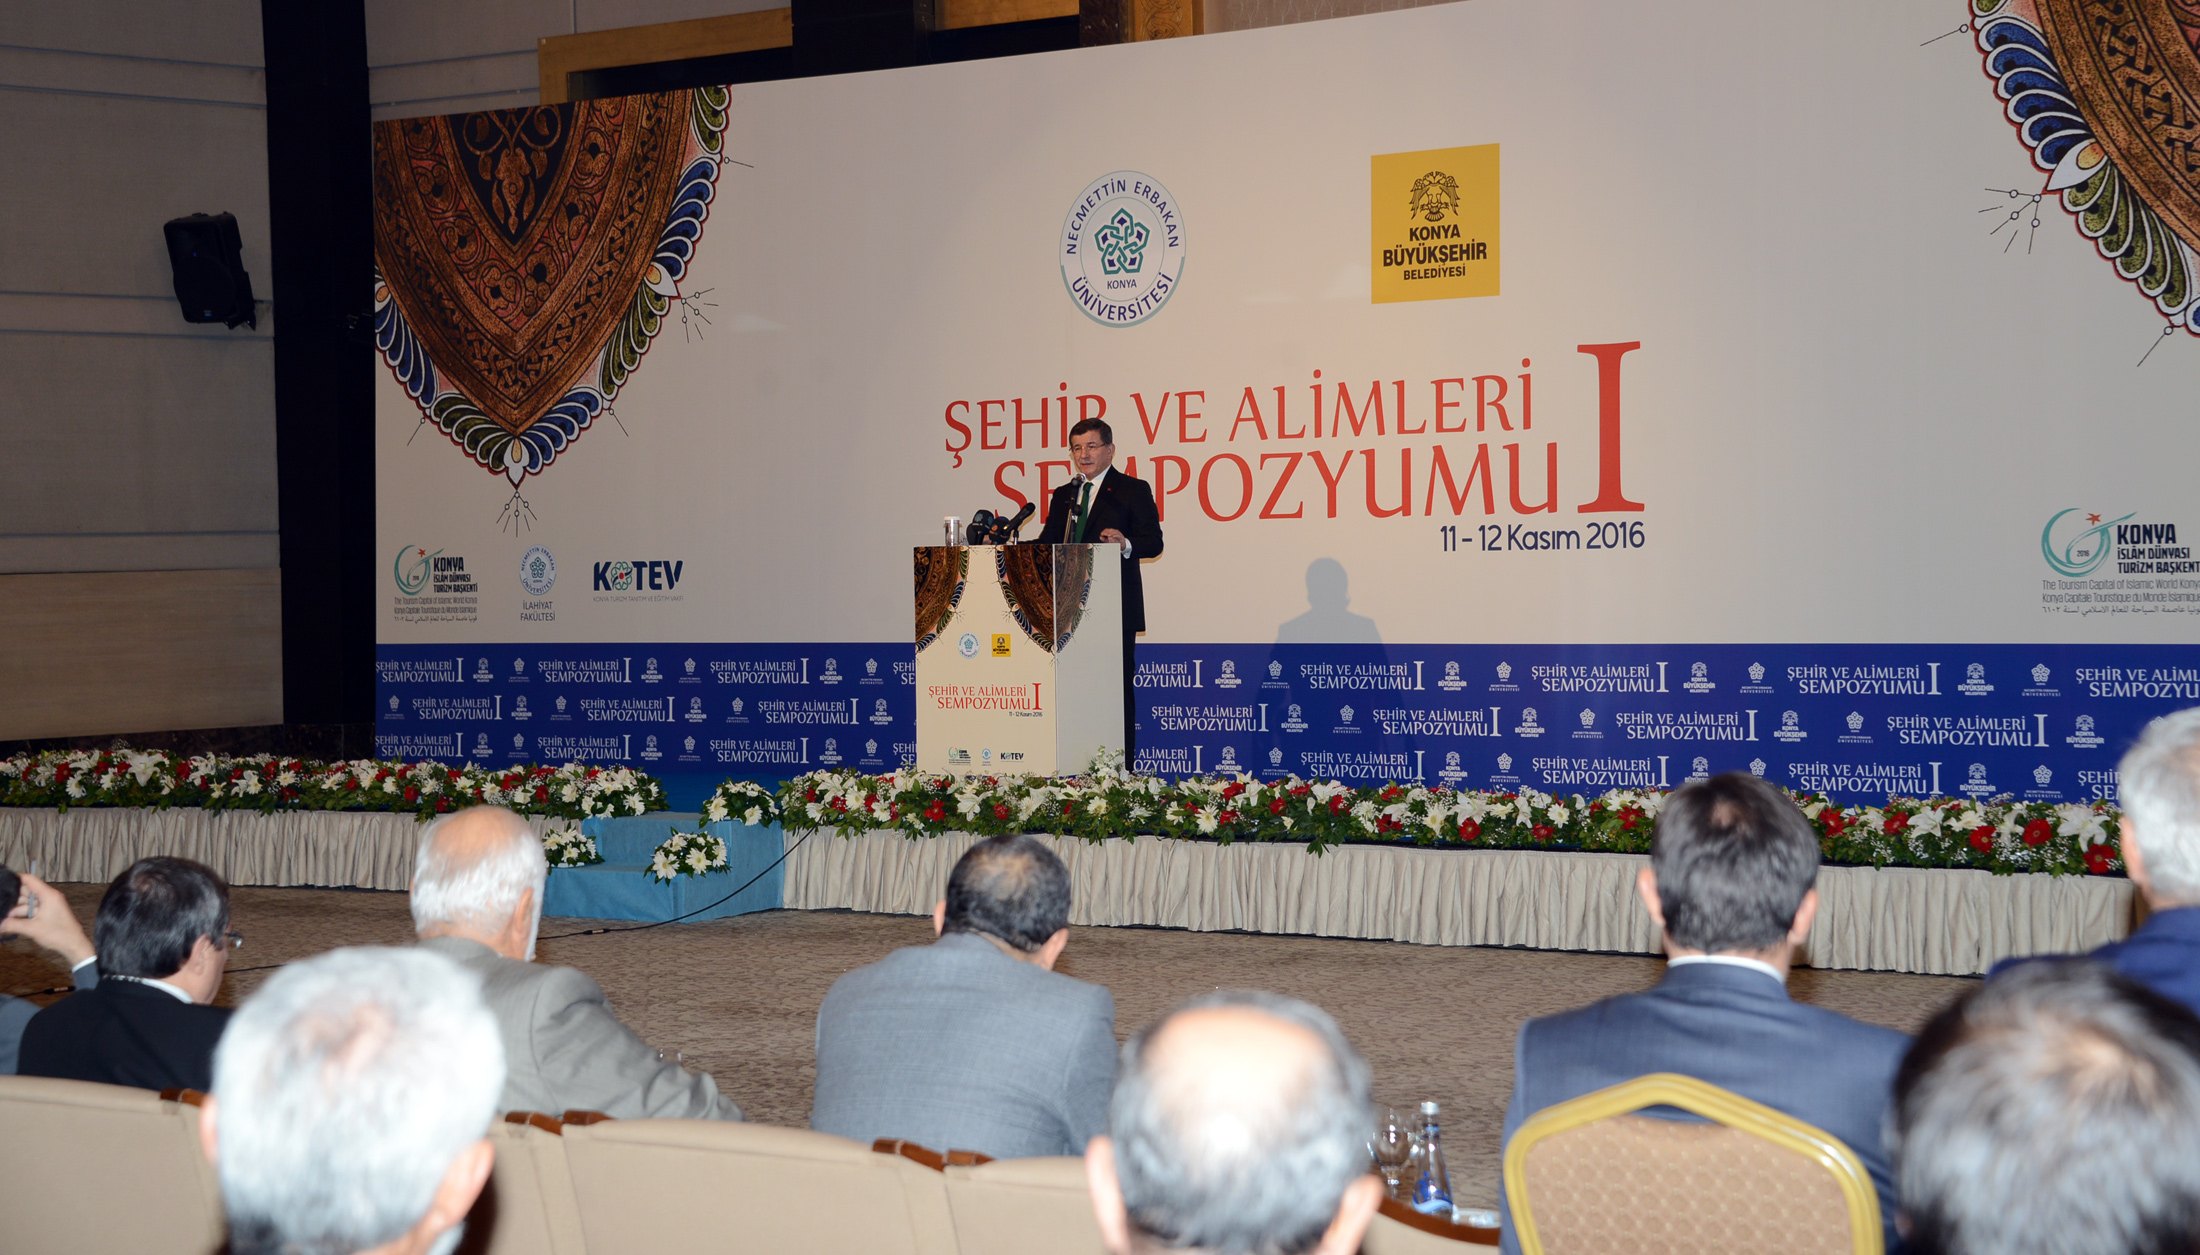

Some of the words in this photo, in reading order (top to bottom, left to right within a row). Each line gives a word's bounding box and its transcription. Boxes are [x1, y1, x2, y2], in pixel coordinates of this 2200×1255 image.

[1066, 178, 1126, 254] NECMETTİN
[1134, 181, 1178, 248] ERBAKAN
[1409, 224, 1460, 241] KONYA
[1383, 238, 1487, 266] BÜYÜKŞEHİR
[1404, 264, 1466, 280] BELEDİYESİ
[1107, 278, 1137, 290] KONYA
[1072, 272, 1173, 321] ÜNİVERSİTESİ
[1130, 390, 1207, 445] VE
[1228, 358, 1531, 441] ALİMLERİ
[994, 442, 1557, 524] SEPOZYUMU
[1577, 341, 1645, 514] I
[1440, 525, 1456, 552] 11
[1478, 524, 1502, 551] 12
[1508, 524, 1580, 550] Kasım
[1586, 521, 1645, 549] 2016
[2117, 524, 2176, 545] KONYA
[2117, 546, 2145, 560] İSLÂM
[2148, 545, 2190, 559] DÜNYASI
[434, 557, 464, 572] KONYA
[2117, 561, 2153, 573] TURİZM
[2156, 561, 2200, 575] BAŞKENT
[449, 572, 471, 582] DÜNYASI
[2042, 580, 2056, 590] The
[2058, 580, 2087, 590] Tourism
[2089, 580, 2115, 590] Capital
[2117, 580, 2124, 589] of
[2126, 579, 2154, 589] Islamic
[2156, 579, 2179, 589] World
[434, 584, 452, 593] TURİZM
[453, 582, 478, 594] BAŞKENTİ
[523, 578, 552, 593] ÜNİVERSİTESİ
[523, 600, 553, 610] İLAHİYAT
[2042, 593, 2063, 604] Konya
[2064, 593, 2092, 603] Capitale
[521, 611, 555, 621] FAKÜLTESİ
[376, 660, 399, 673] ŞEHİR
[401, 662, 412, 670] VE
[414, 660, 452, 670] ALİMLERİ
[456, 658, 464, 682] I
[538, 660, 561, 673] ŞEHİR
[565, 662, 576, 670] VE
[579, 660, 618, 670] ALİMLERİ
[624, 658, 631, 682] I
[710, 660, 736, 673] ŞEHİR
[739, 662, 750, 671] VE
[754, 660, 795, 671] ALİMLERİ
[800, 658, 809, 684] I
[1138, 662, 1187, 674] ALİMLERİ
[1193, 660, 1203, 688] I
[1301, 662, 1333, 678] ŞEHİR
[1336, 665, 1351, 675] VE
[1354, 663, 1407, 676] ALİMLERİ
[1532, 663, 1567, 680] ŞEHİR
[1571, 666, 1587, 677] VE
[1591, 664, 1649, 677] ALİMLERİ
[1788, 664, 1827, 681] ŞEHİR
[1832, 667, 1849, 678] VE
[1854, 665, 1919, 679] ALİMLERİ
[382, 671, 454, 682] SEMPOZYUMU
[546, 671, 621, 682] SEMPOZYUMU
[718, 672, 798, 684] SEMPOZYUMU
[1133, 675, 1190, 687] OZYUMU
[1310, 676, 1411, 690] SEMPOZYUMU
[1414, 661, 1425, 690] I
[1656, 662, 1669, 692] I
[1927, 663, 1941, 694] I
[2076, 666, 2122, 684] ŞEHİR
[2126, 669, 2147, 681] VE
[2152, 666, 2200, 681] ALİML
[929, 684, 958, 698] ŞEHİR
[962, 686, 975, 696] VE
[978, 684, 1027, 697] ALİMLERİ
[1542, 678, 1654, 692] SEMPOZYUMU
[1800, 680, 1924, 694] SEMPOZYUMU
[2090, 682, 2198, 698] SEMPOZYU
[413, 697, 436, 710] ŞEHİR
[439, 699, 449, 707] VE
[452, 697, 490, 708] ALİMLERİ
[580, 698, 605, 710] ŞEHİR
[608, 700, 619, 709] VE
[622, 698, 662, 709] ALİMLERİ
[938, 697, 1030, 710] SEMPOZYUMU
[1032, 683, 1042, 710] I
[420, 708, 492, 720] SEMPOZYUMU
[494, 696, 502, 720] I
[667, 697, 675, 722] I
[758, 700, 785, 713] ŞEHİR
[788, 702, 799, 711] VE
[802, 700, 845, 711] ALİMLERİ
[850, 698, 859, 724] I
[1152, 706, 1182, 719] ŞEHİR
[1186, 707, 1199, 717] VE
[1202, 705, 1252, 717] ALİMLERİ
[1373, 706, 1406, 720] ŞEHİR
[1410, 710, 1425, 720] VE
[1428, 708, 1482, 722] ALİMLERİ
[588, 710, 665, 722] SEMPOZYUMU
[766, 712, 848, 724] SEMPOZYUMU
[1258, 704, 1269, 732] I
[1490, 707, 1501, 736] I
[1616, 711, 1653, 727] ŞEHİR
[1657, 714, 1674, 724] VE
[1678, 712, 1738, 725] ALİMLERİ
[1888, 714, 1929, 731] ŞEHİR
[1934, 718, 1952, 729] VE
[1957, 715, 2025, 730] ALİMLERİ
[1161, 718, 1256, 731] SEMPOZYUMU
[1383, 721, 1487, 736] SEMPOZYUMU
[1627, 725, 1743, 740] SEMPOZYUMU
[1746, 710, 1759, 741] I
[2034, 714, 2049, 747] I
[710, 738, 736, 751] ŞEHİR
[739, 741, 750, 750] VE
[753, 739, 795, 750] ALİMLERİ
[1900, 730, 2031, 746] SEMPOZYUMU
[718, 750, 798, 763] SEMPOZYUMU
[800, 738, 809, 763] I
[1301, 750, 1333, 765] ŞEHİR
[1337, 753, 1351, 763] VE
[1355, 752, 1407, 765] ALİMLERİ
[1311, 764, 1412, 779] SEMPOZYUMU
[1414, 751, 1426, 780] I
[1533, 756, 1568, 772] ŞEHİR
[1572, 759, 1588, 770] VE
[1592, 757, 1650, 771] ALİMLERİ
[1657, 756, 1670, 786] I
[1789, 761, 1829, 778] ŞEHİR
[1833, 764, 1851, 776] VE
[1855, 763, 1920, 778] ALİMLERİ
[1543, 770, 1655, 787] SEMPOZYUMU
[1801, 776, 1926, 794] SEMPOZYUMU
[1929, 762, 1943, 794] I
